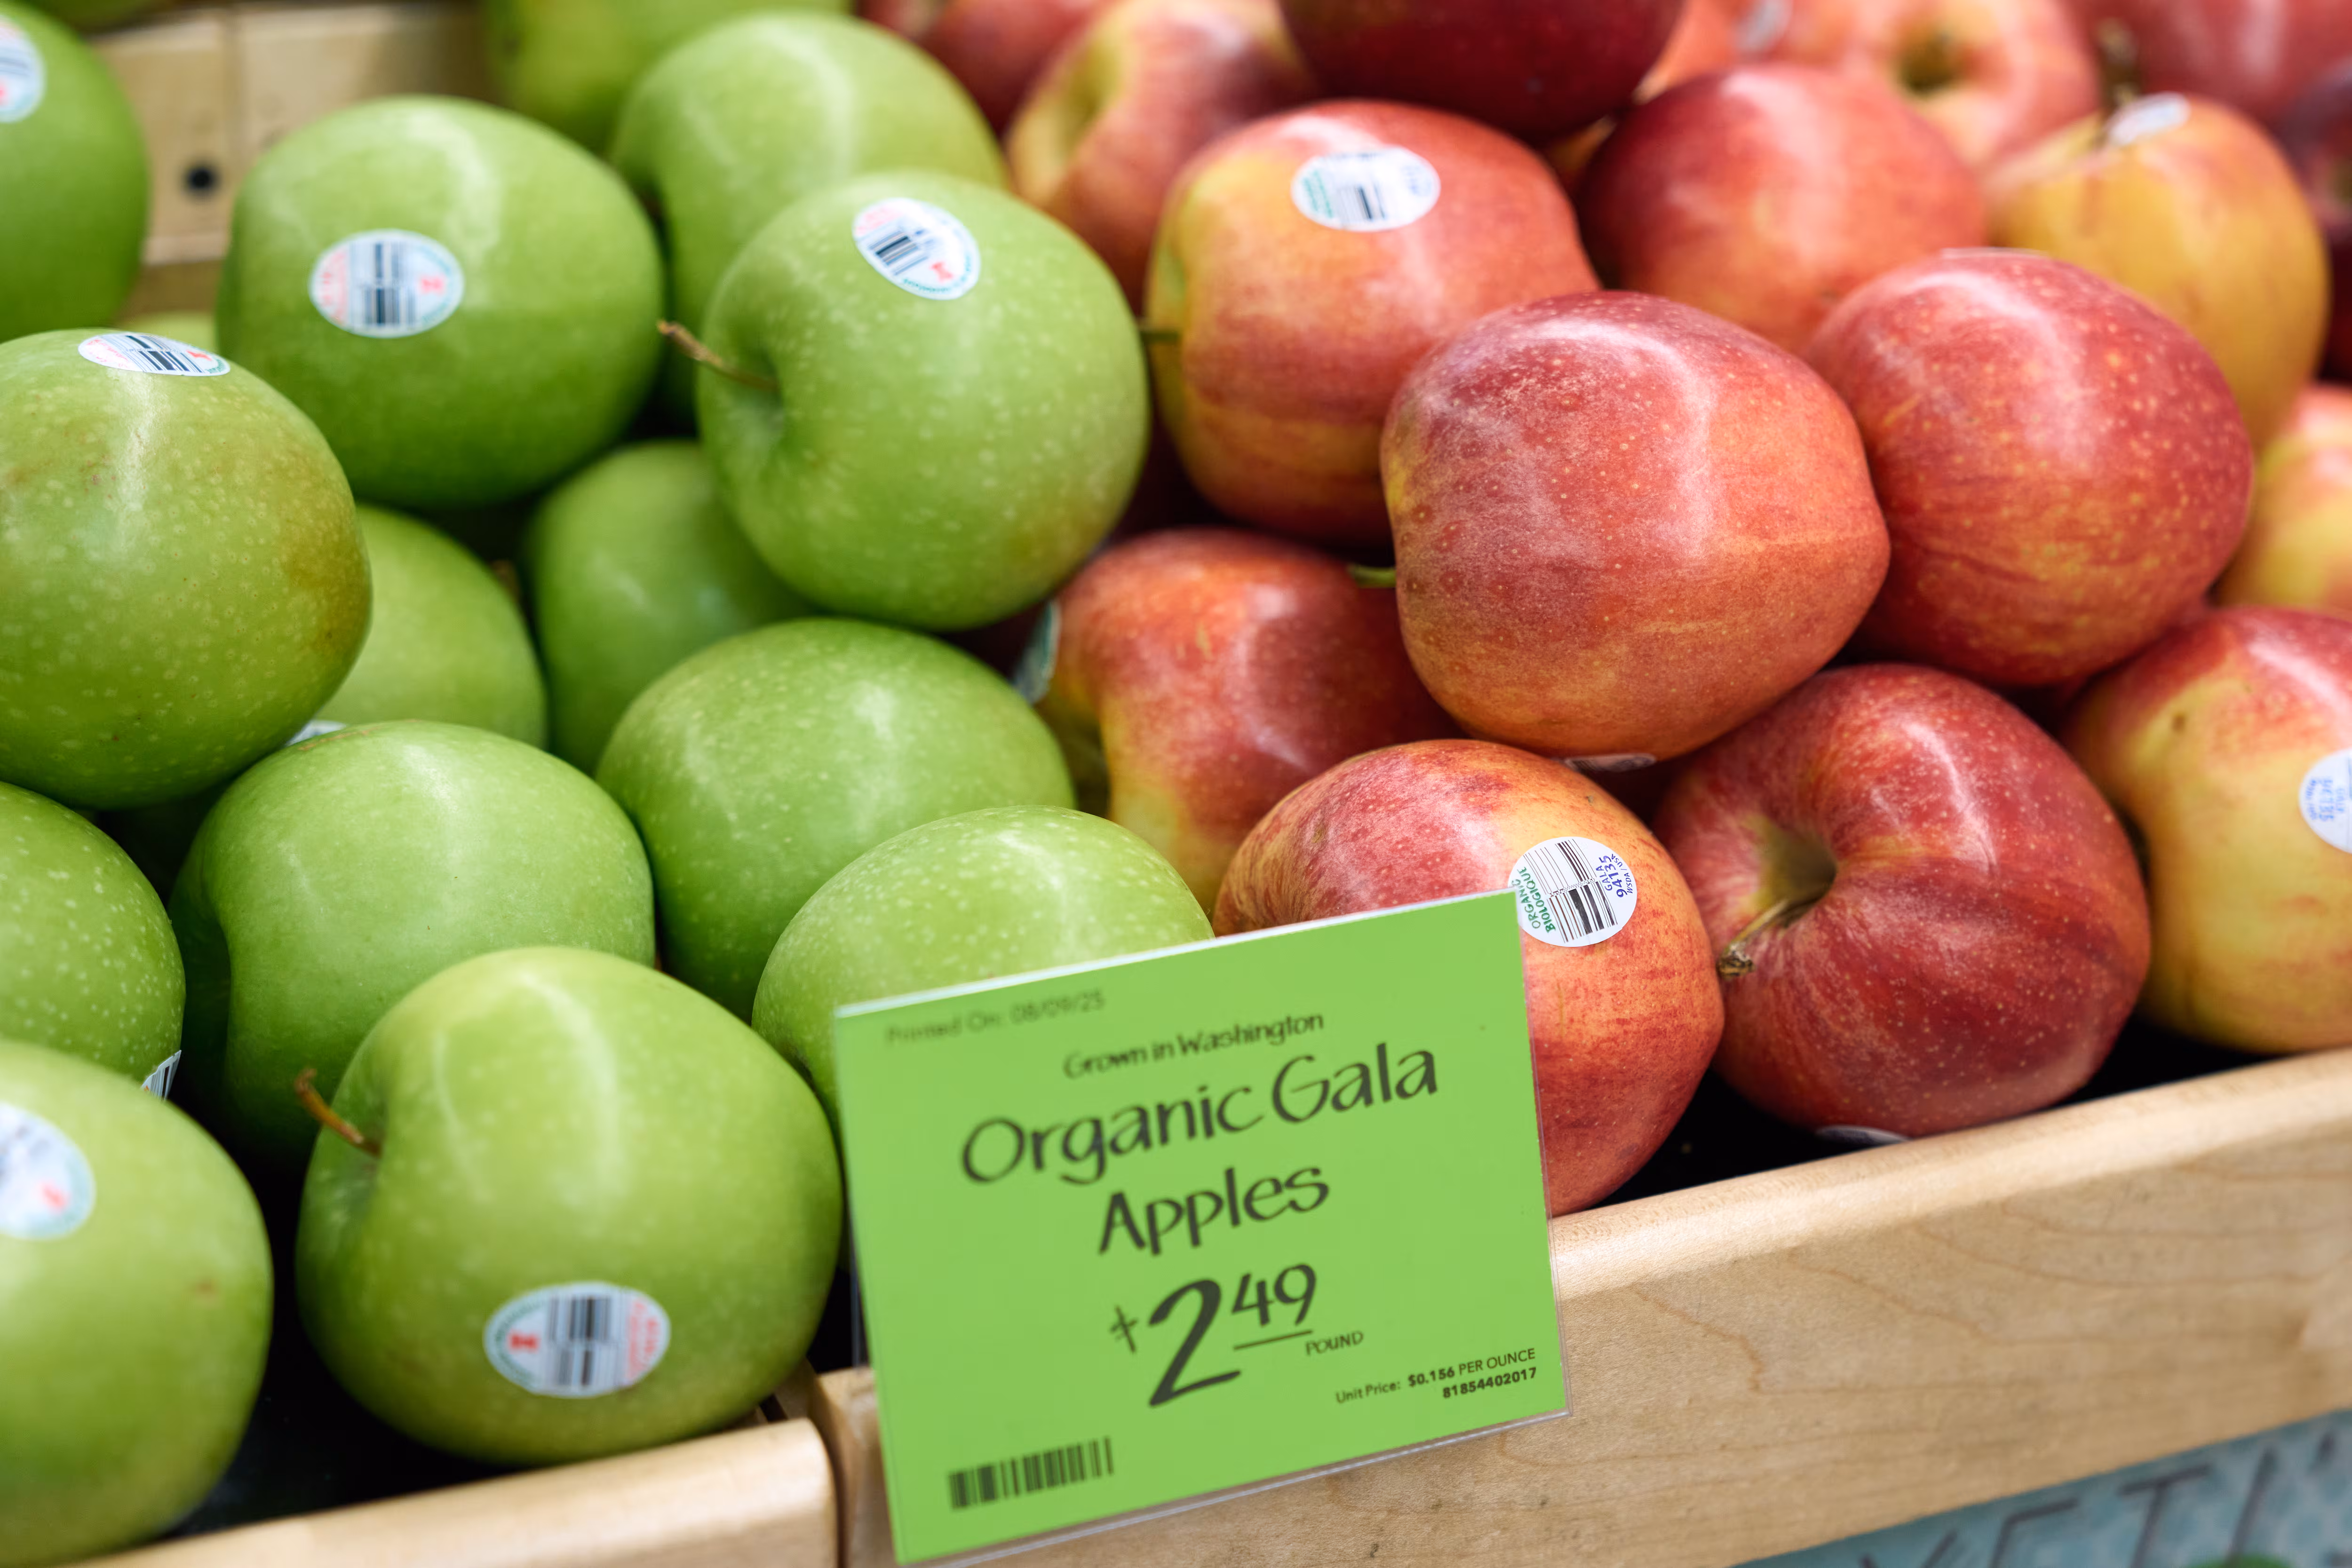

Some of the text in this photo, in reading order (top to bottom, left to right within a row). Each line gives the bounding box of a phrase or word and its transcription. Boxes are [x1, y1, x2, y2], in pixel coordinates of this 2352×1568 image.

[1596, 865, 1613, 891] GALA
[1598, 855, 1628, 898] 94135
[1611, 853, 1623, 868] USA
[1623, 872, 1633, 894] WSDA
[1511, 879, 1541, 929] ORGANIC
[1518, 866, 1556, 933] BIOLOGIQUE
[1063, 1014, 1324, 1079] Grown in Washington
[959, 1041, 1438, 1187] Organic Gala
[1097, 1165, 1331, 1258] Apples
[1304, 1330, 1364, 1356] POUND
[1335, 1347, 1536, 1404] Unit Price: $0.156 PER OUNCE
[1442, 1366, 1537, 1399] 81854402017
